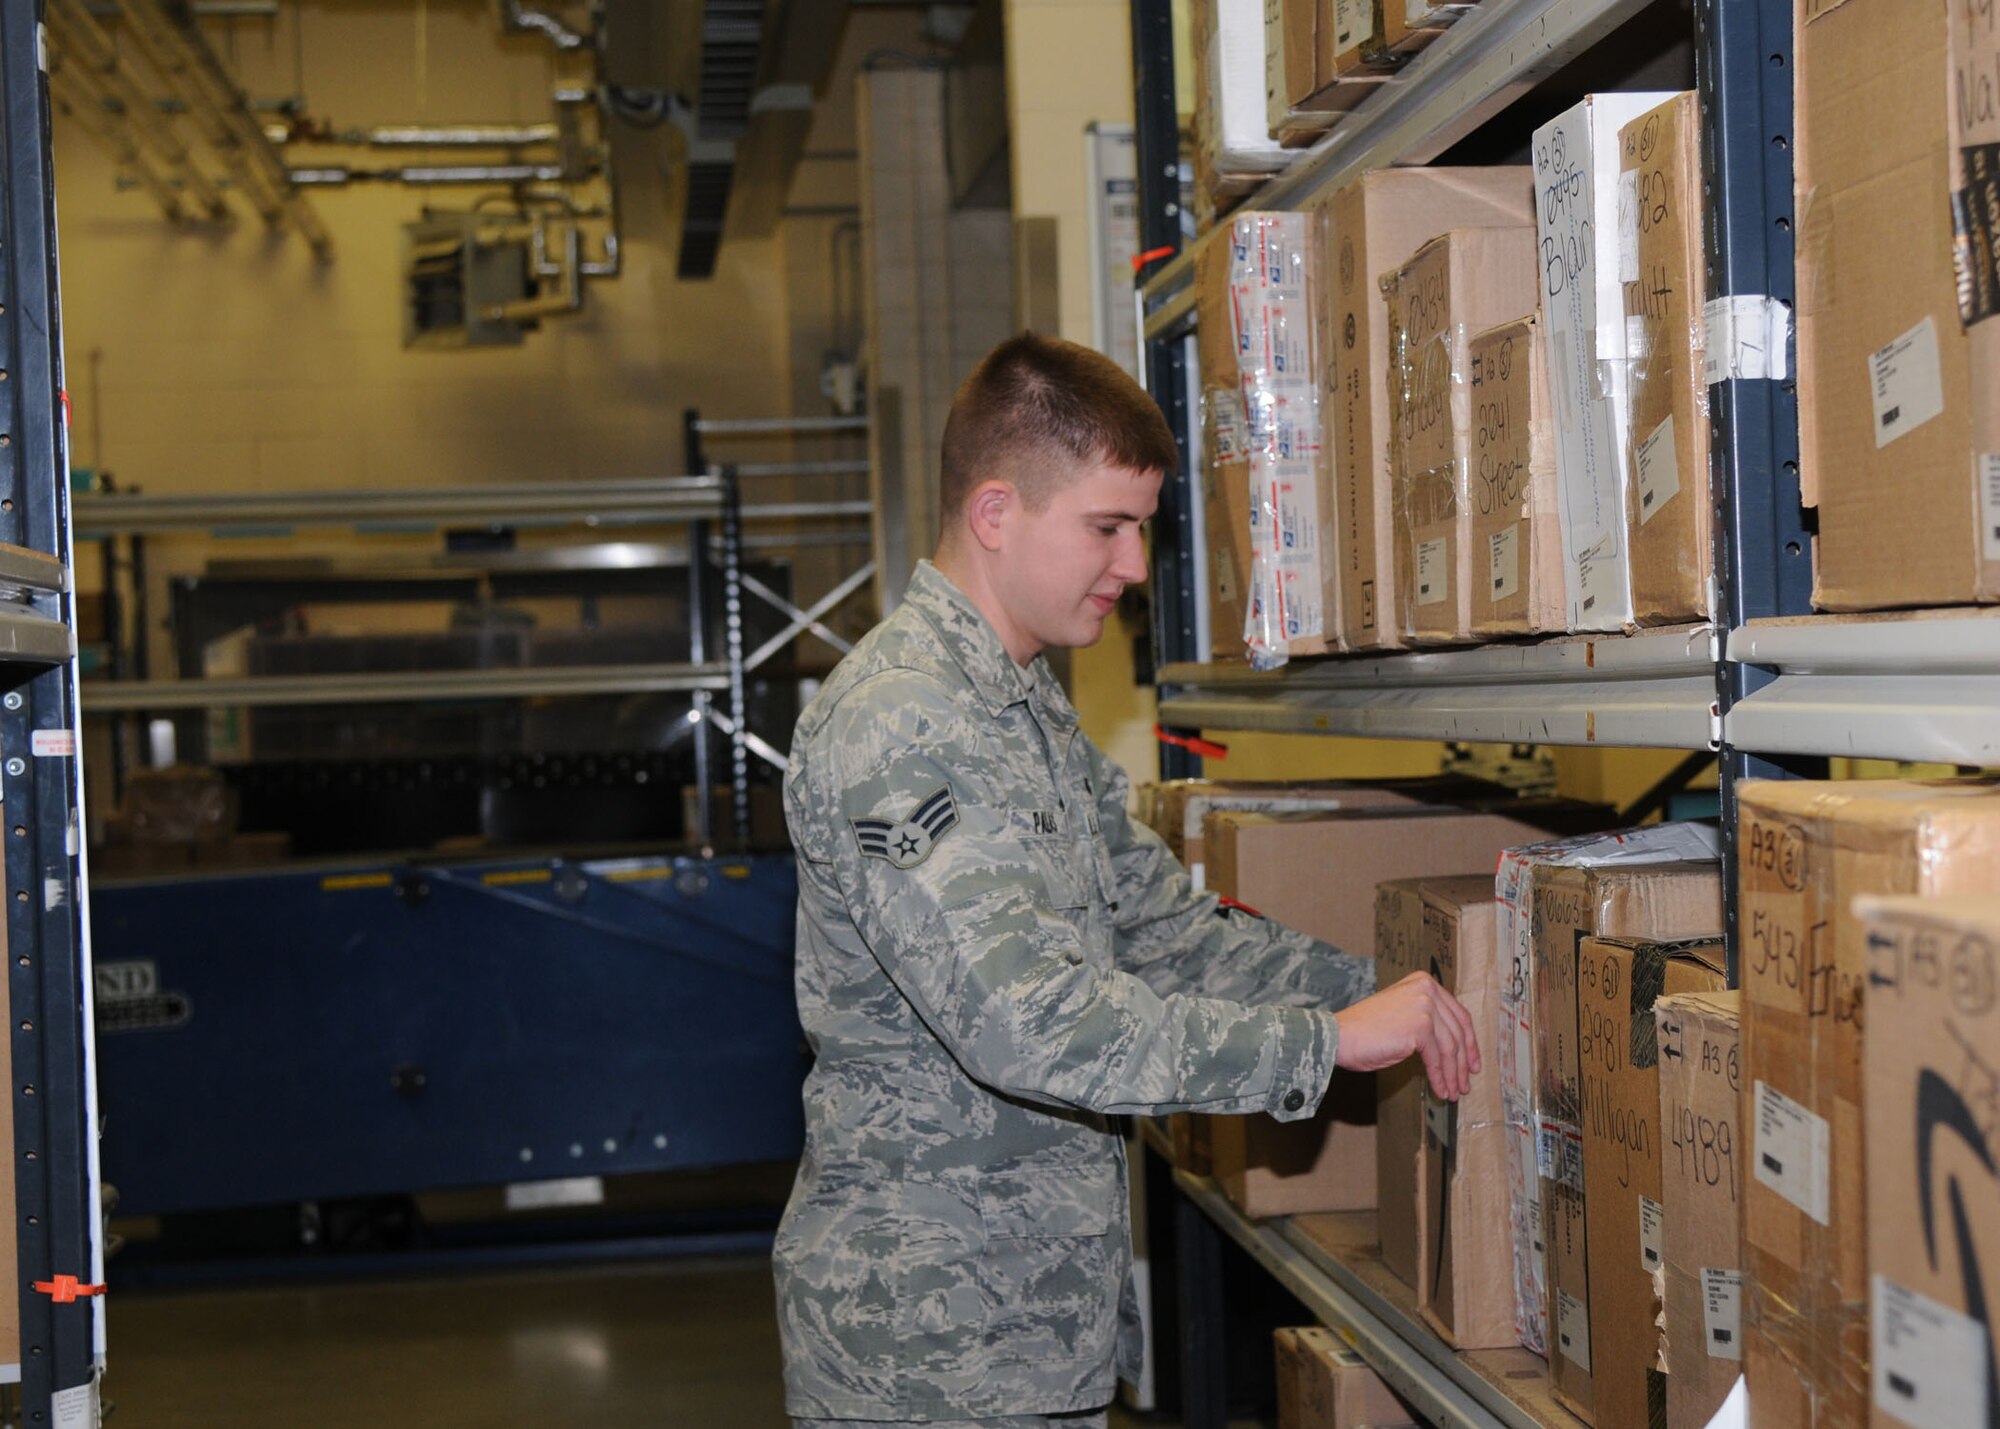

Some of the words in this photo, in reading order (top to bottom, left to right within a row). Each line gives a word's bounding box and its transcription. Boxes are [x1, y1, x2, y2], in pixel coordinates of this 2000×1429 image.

[1638, 171, 1669, 233] 82
[1541, 220, 1590, 297] Blair
[1479, 392, 1511, 448] 2041
[1479, 448, 1523, 514] Street
[1750, 822, 1776, 871] A3
[1582, 955, 1597, 988] A3
[1581, 1003, 1623, 1073] 2981
[1702, 1040, 1721, 1075] A3
[1581, 1072, 1651, 1189] Milligan
[1672, 1098, 1736, 1203] 4989
